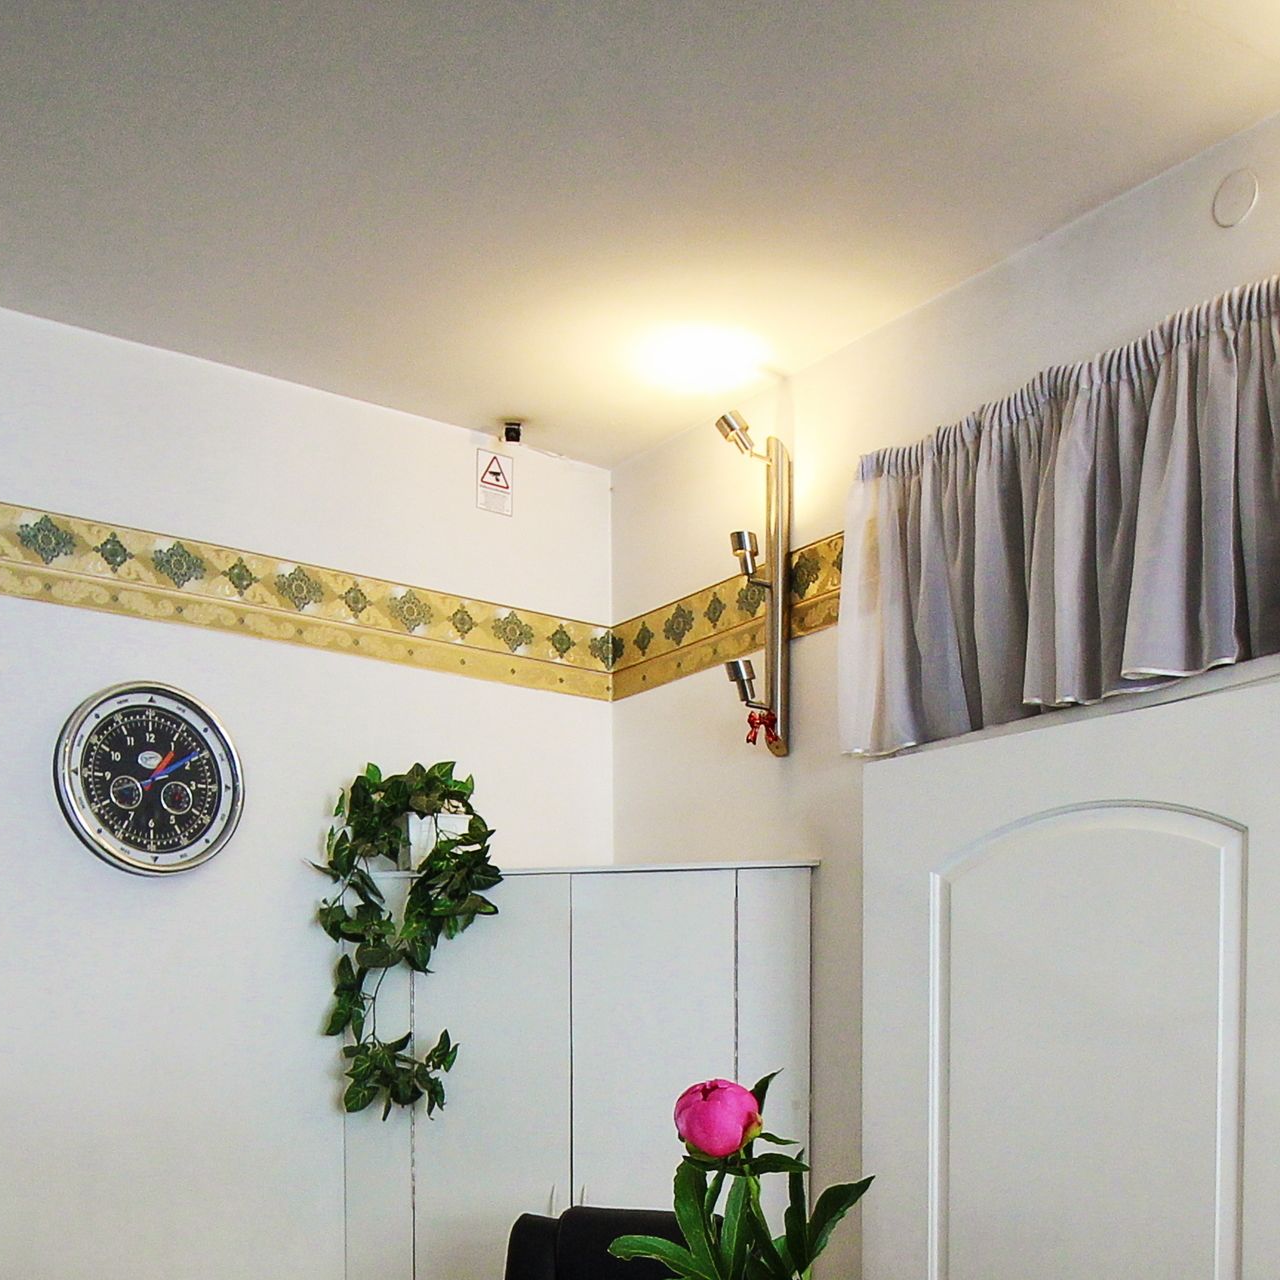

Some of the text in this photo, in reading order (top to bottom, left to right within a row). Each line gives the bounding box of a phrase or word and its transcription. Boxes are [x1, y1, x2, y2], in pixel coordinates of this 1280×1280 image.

[126, 736, 135, 746] 11
[145, 732, 156, 743] 12
[110, 751, 121, 761] 10
